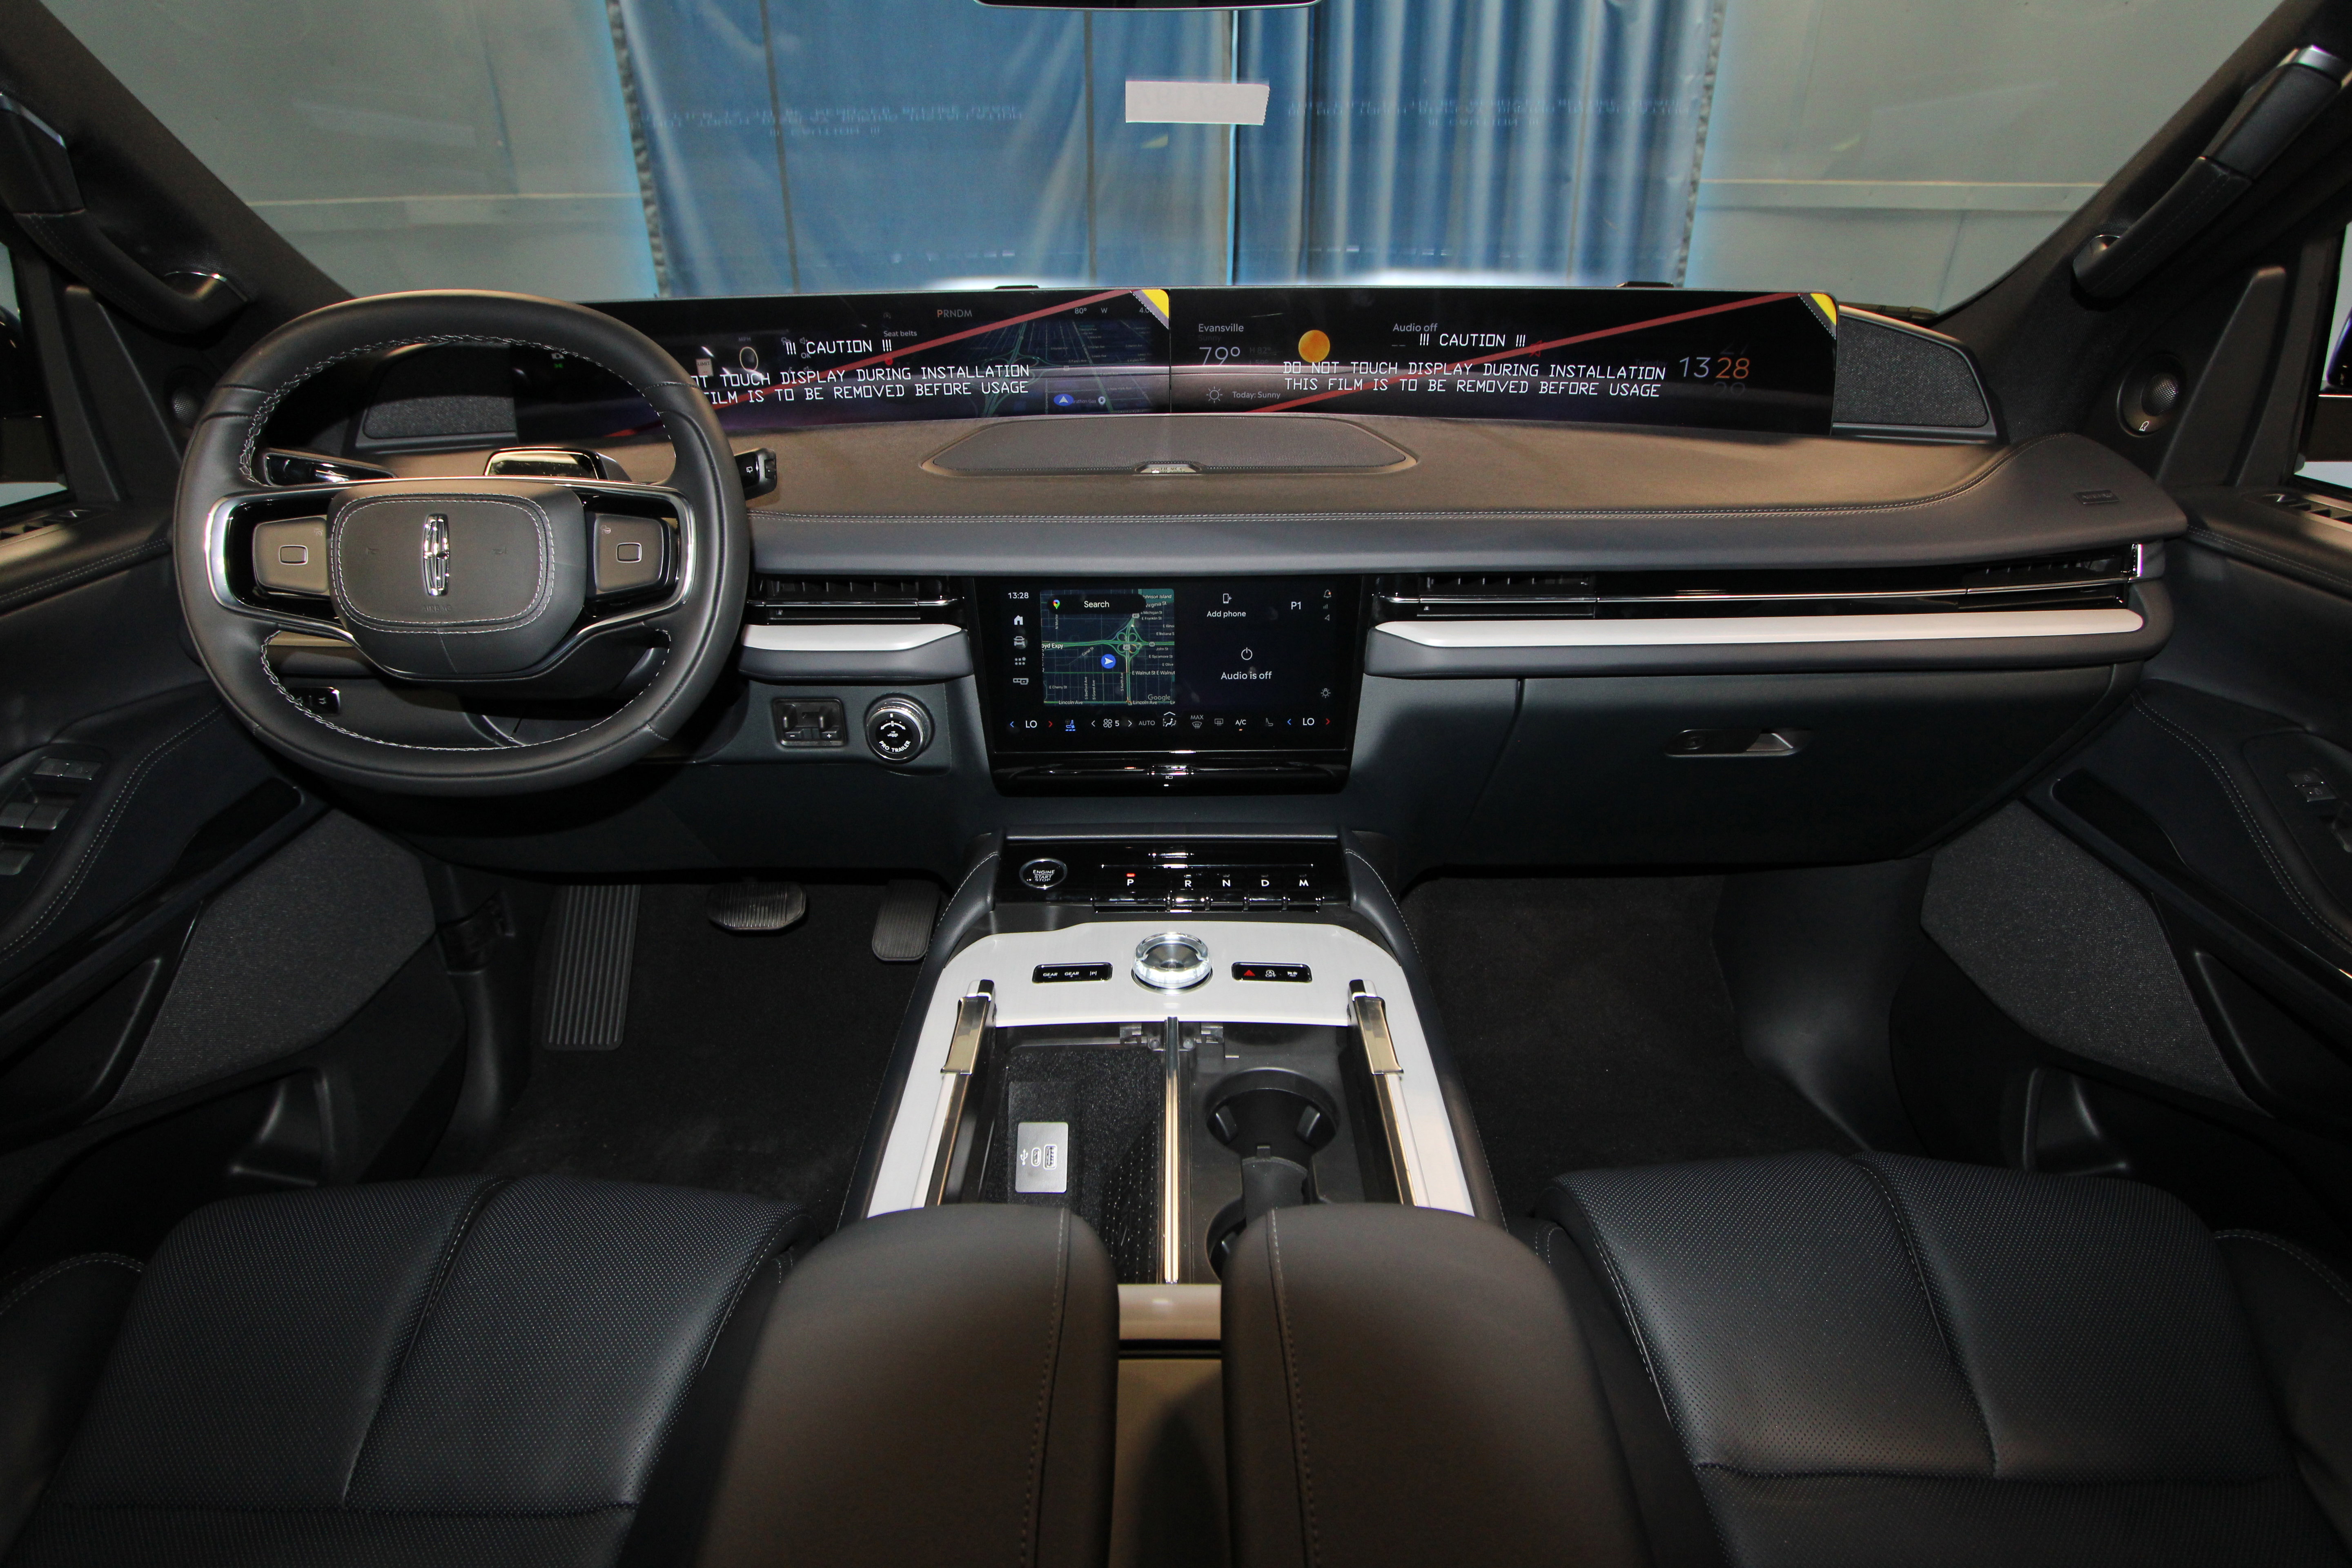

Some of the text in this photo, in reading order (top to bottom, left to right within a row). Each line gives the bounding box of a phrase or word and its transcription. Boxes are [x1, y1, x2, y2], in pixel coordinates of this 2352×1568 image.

[937, 309, 973, 318] PRNDM
[1198, 323, 1244, 332] Evansville
[1392, 323, 1438, 332] Audio off
[806, 339, 873, 354] CAUTION
[1439, 333, 1506, 347] CAUTION
[1283, 361, 1301, 374] DO
[1312, 361, 1340, 374] NOT
[1350, 361, 1398, 375] TOUCH
[1408, 362, 1473, 376] DISPLAY
[1482, 363, 1539, 377] DURING
[1549, 364, 1666, 380] INSTALLATION
[1715, 356, 1750, 379] 28
[690, 364, 1029, 388] OT TOUCH DISPLAY DURING INSTALLATION
[747, 390, 764, 403] IS
[774, 388, 795, 401] TO
[804, 387, 824, 400] BE
[833, 384, 905, 399] REMOVED
[914, 381, 972, 396] BEFORE
[981, 380, 1029, 394] USAGE
[1284, 377, 1661, 397] THIS FILM IS TO BE REMOVED BEFORE USAGE
[1232, 391, 1281, 400] Today: Sunny
[1291, 601, 1302, 610] P1
[1223, 610, 1246, 619] phone
[1259, 671, 1272, 679] off
[879, 740, 911, 753] PRO TRAILER
